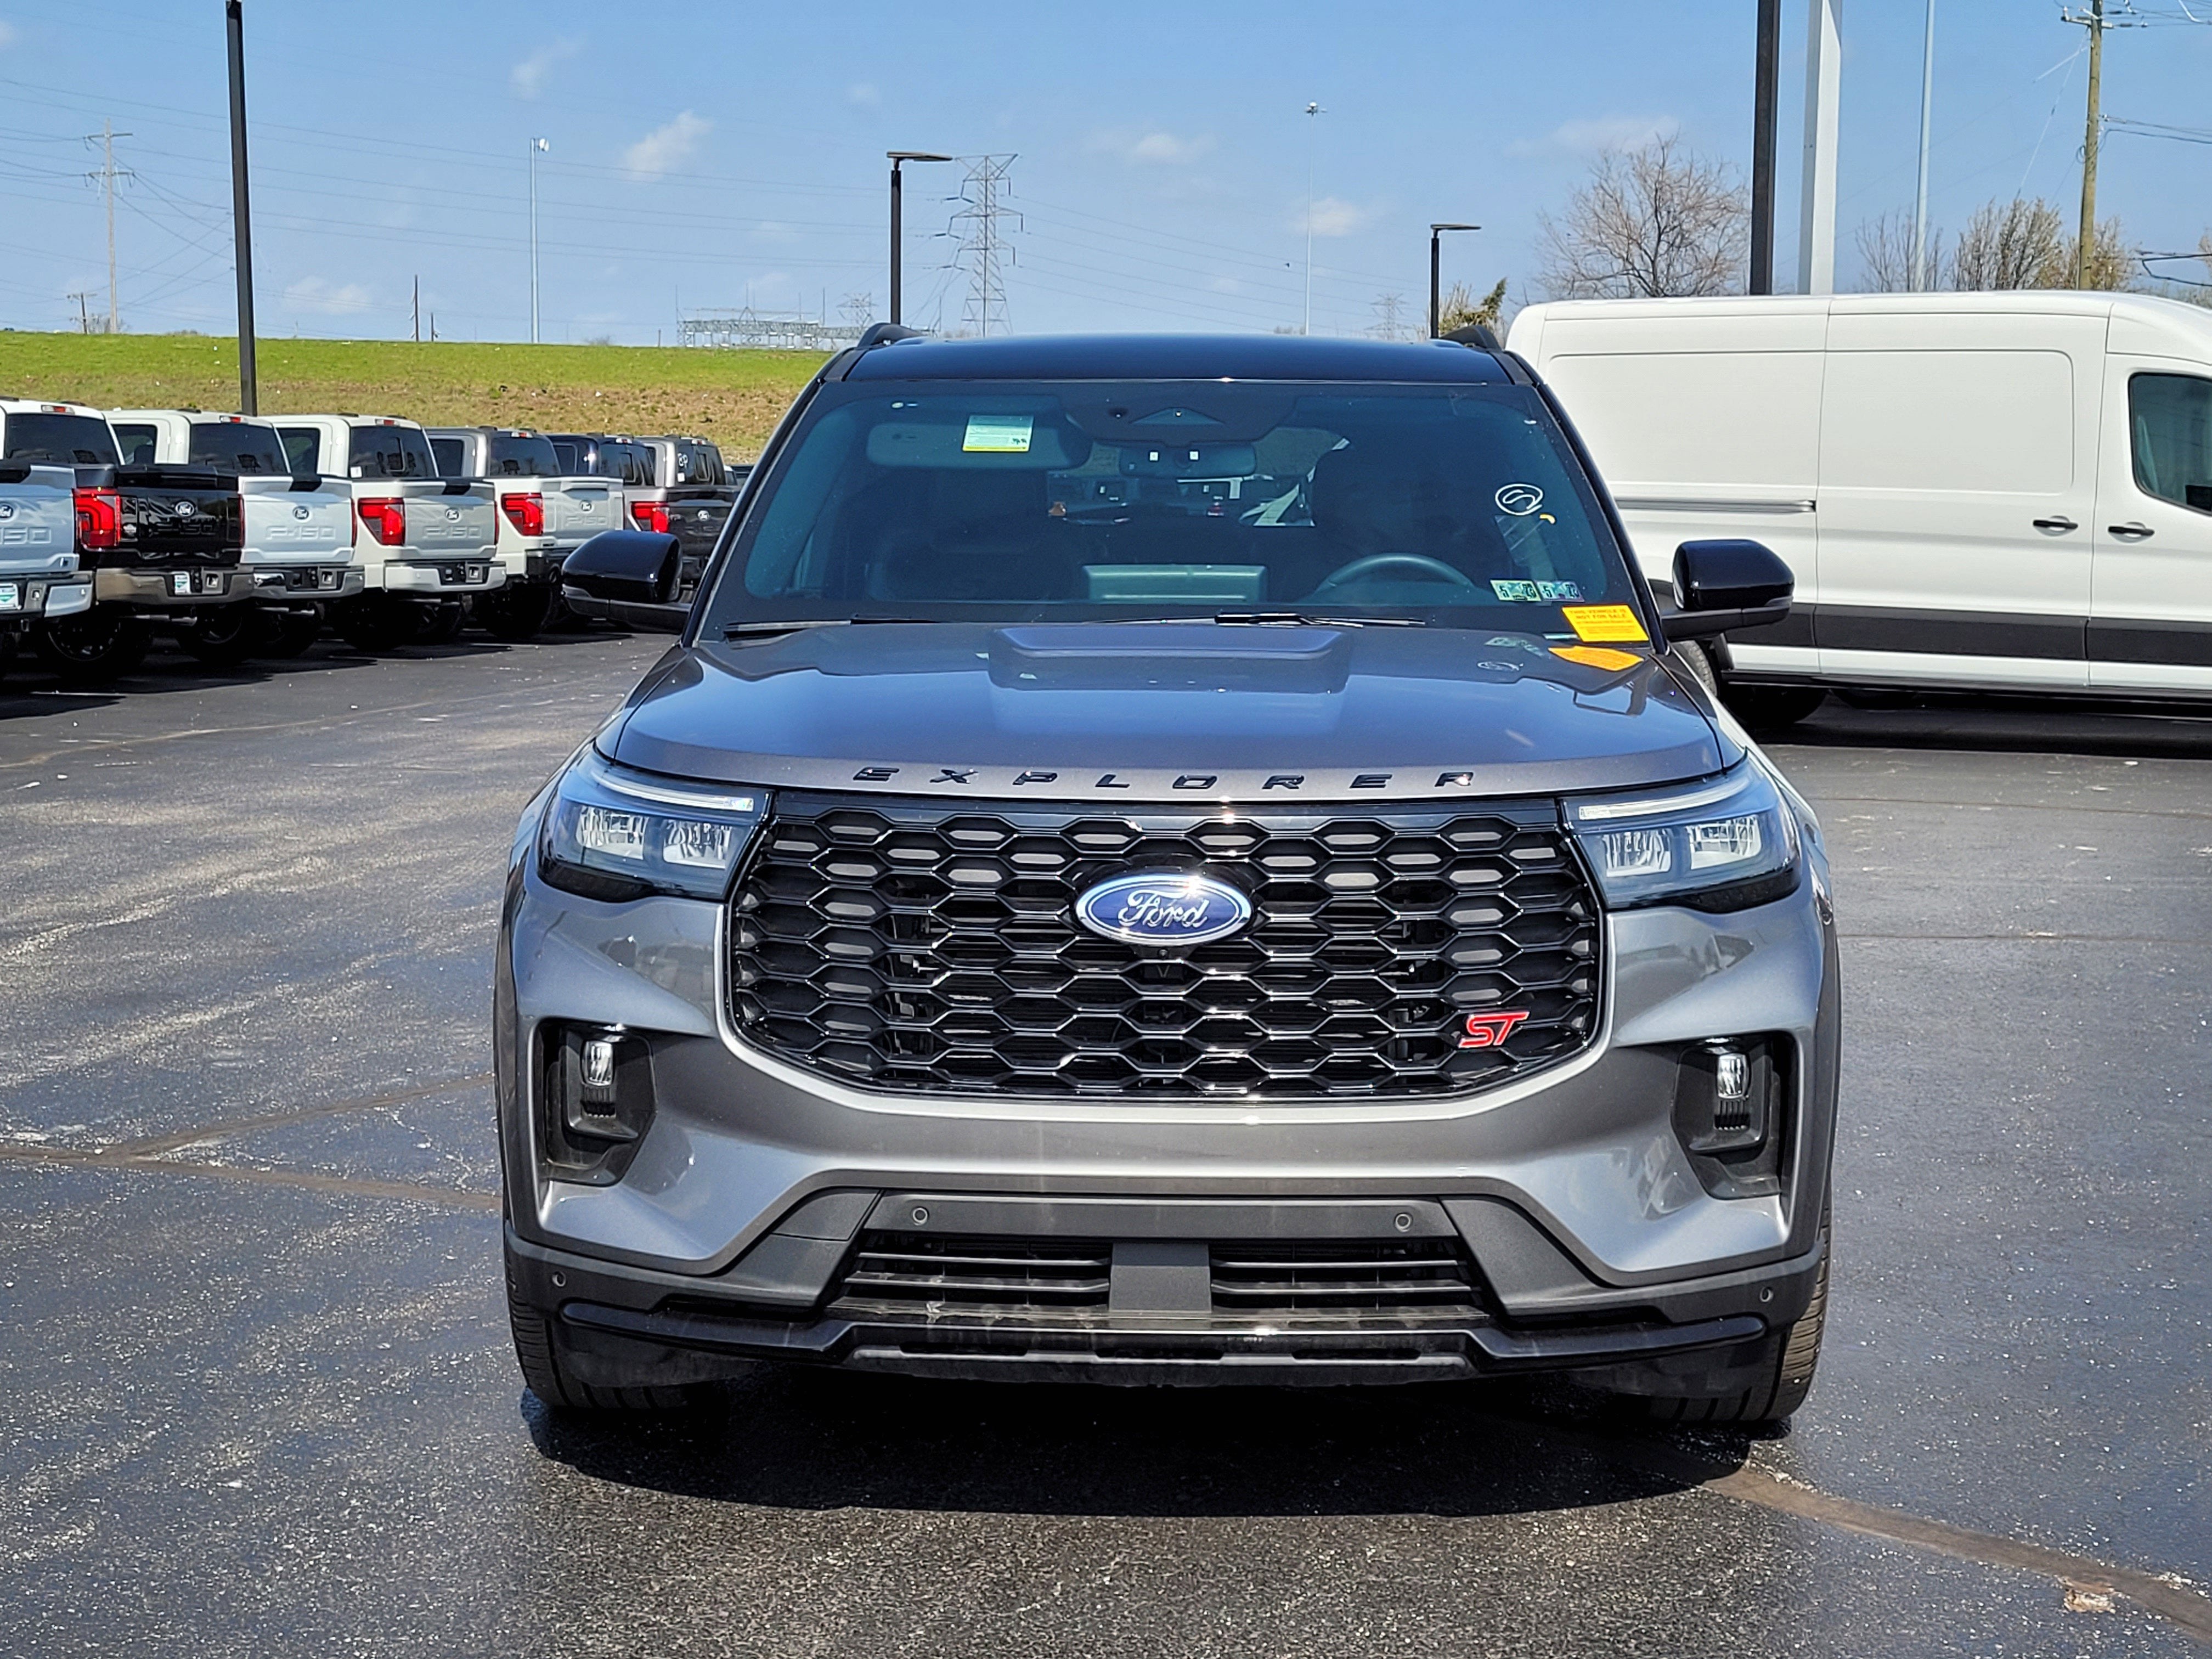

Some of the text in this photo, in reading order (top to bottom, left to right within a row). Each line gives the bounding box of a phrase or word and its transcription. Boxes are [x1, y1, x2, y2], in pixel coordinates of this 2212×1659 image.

[266, 525, 336, 540] F-150
[422, 525, 482, 539] F-150
[853, 766, 1475, 790] EXPLORER
[1118, 889, 1210, 928] Ford
[1458, 1011, 1530, 1048] ST
